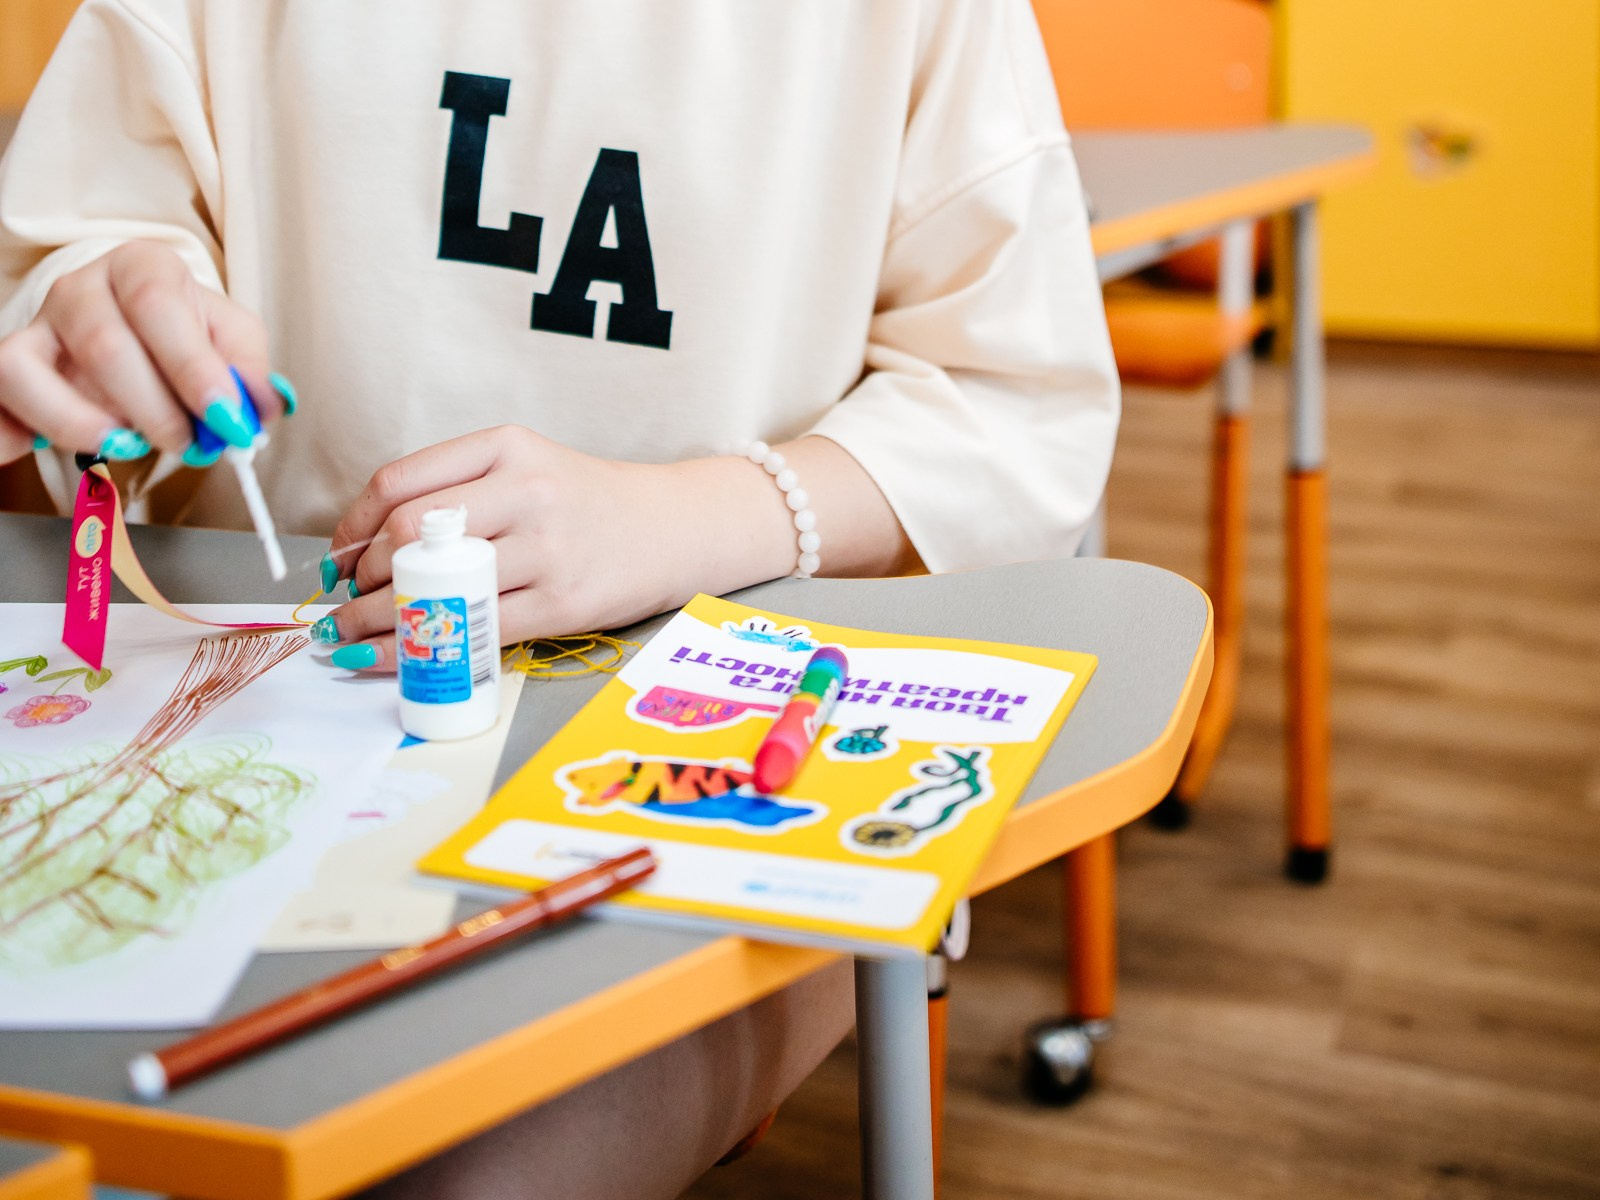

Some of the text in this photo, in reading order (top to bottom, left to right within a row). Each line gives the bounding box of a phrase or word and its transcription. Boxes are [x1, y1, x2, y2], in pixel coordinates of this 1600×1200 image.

[437, 70, 673, 350] LA
[669, 646, 1028, 705] креатиності
[891, 696, 1012, 723] Твоя
